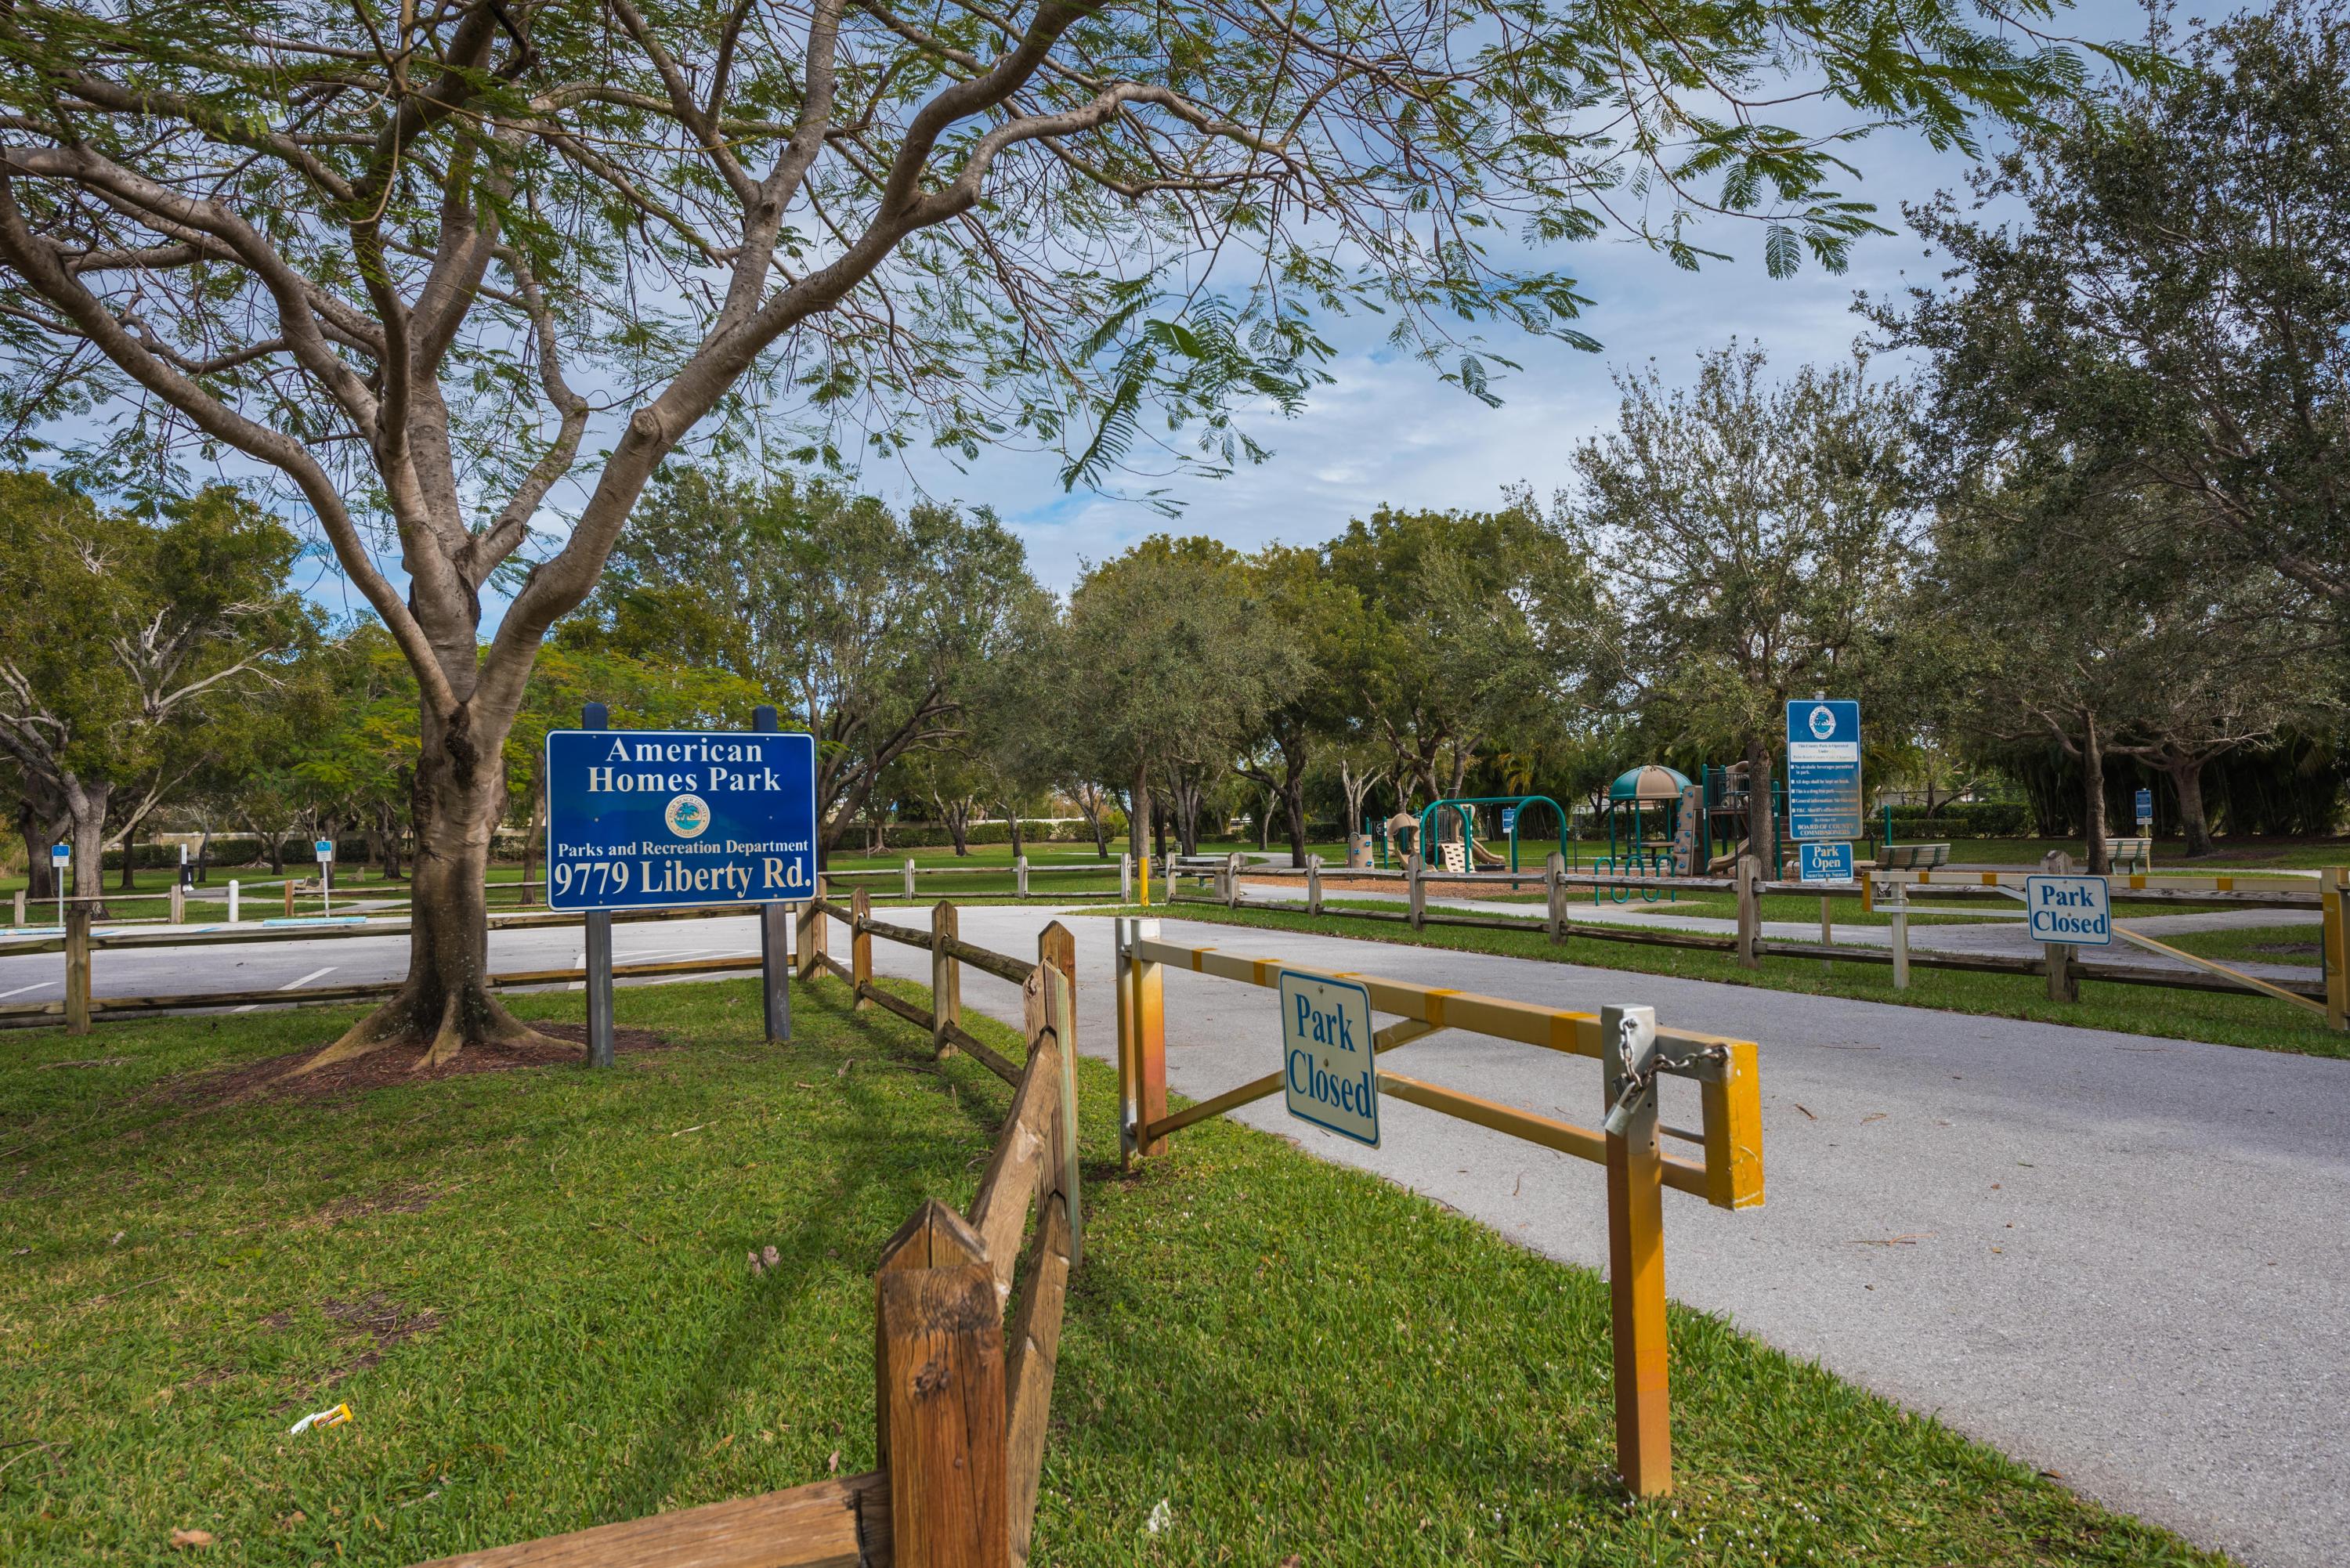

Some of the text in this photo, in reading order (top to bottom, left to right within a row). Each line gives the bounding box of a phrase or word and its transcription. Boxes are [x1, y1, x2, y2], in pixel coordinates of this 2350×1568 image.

[606, 736, 763, 762] American
[587, 766, 782, 793] Homes Park
[558, 839, 808, 858] Parks and Recreation Department
[1813, 846, 1838, 857] Park
[1812, 857, 1840, 871] Open
[554, 857, 812, 898] 9779 Liberty Rd.
[2041, 885, 2095, 907] Park
[2033, 910, 2106, 934] Closed
[1294, 992, 1357, 1053] Park
[1289, 1049, 1373, 1119] Closed
